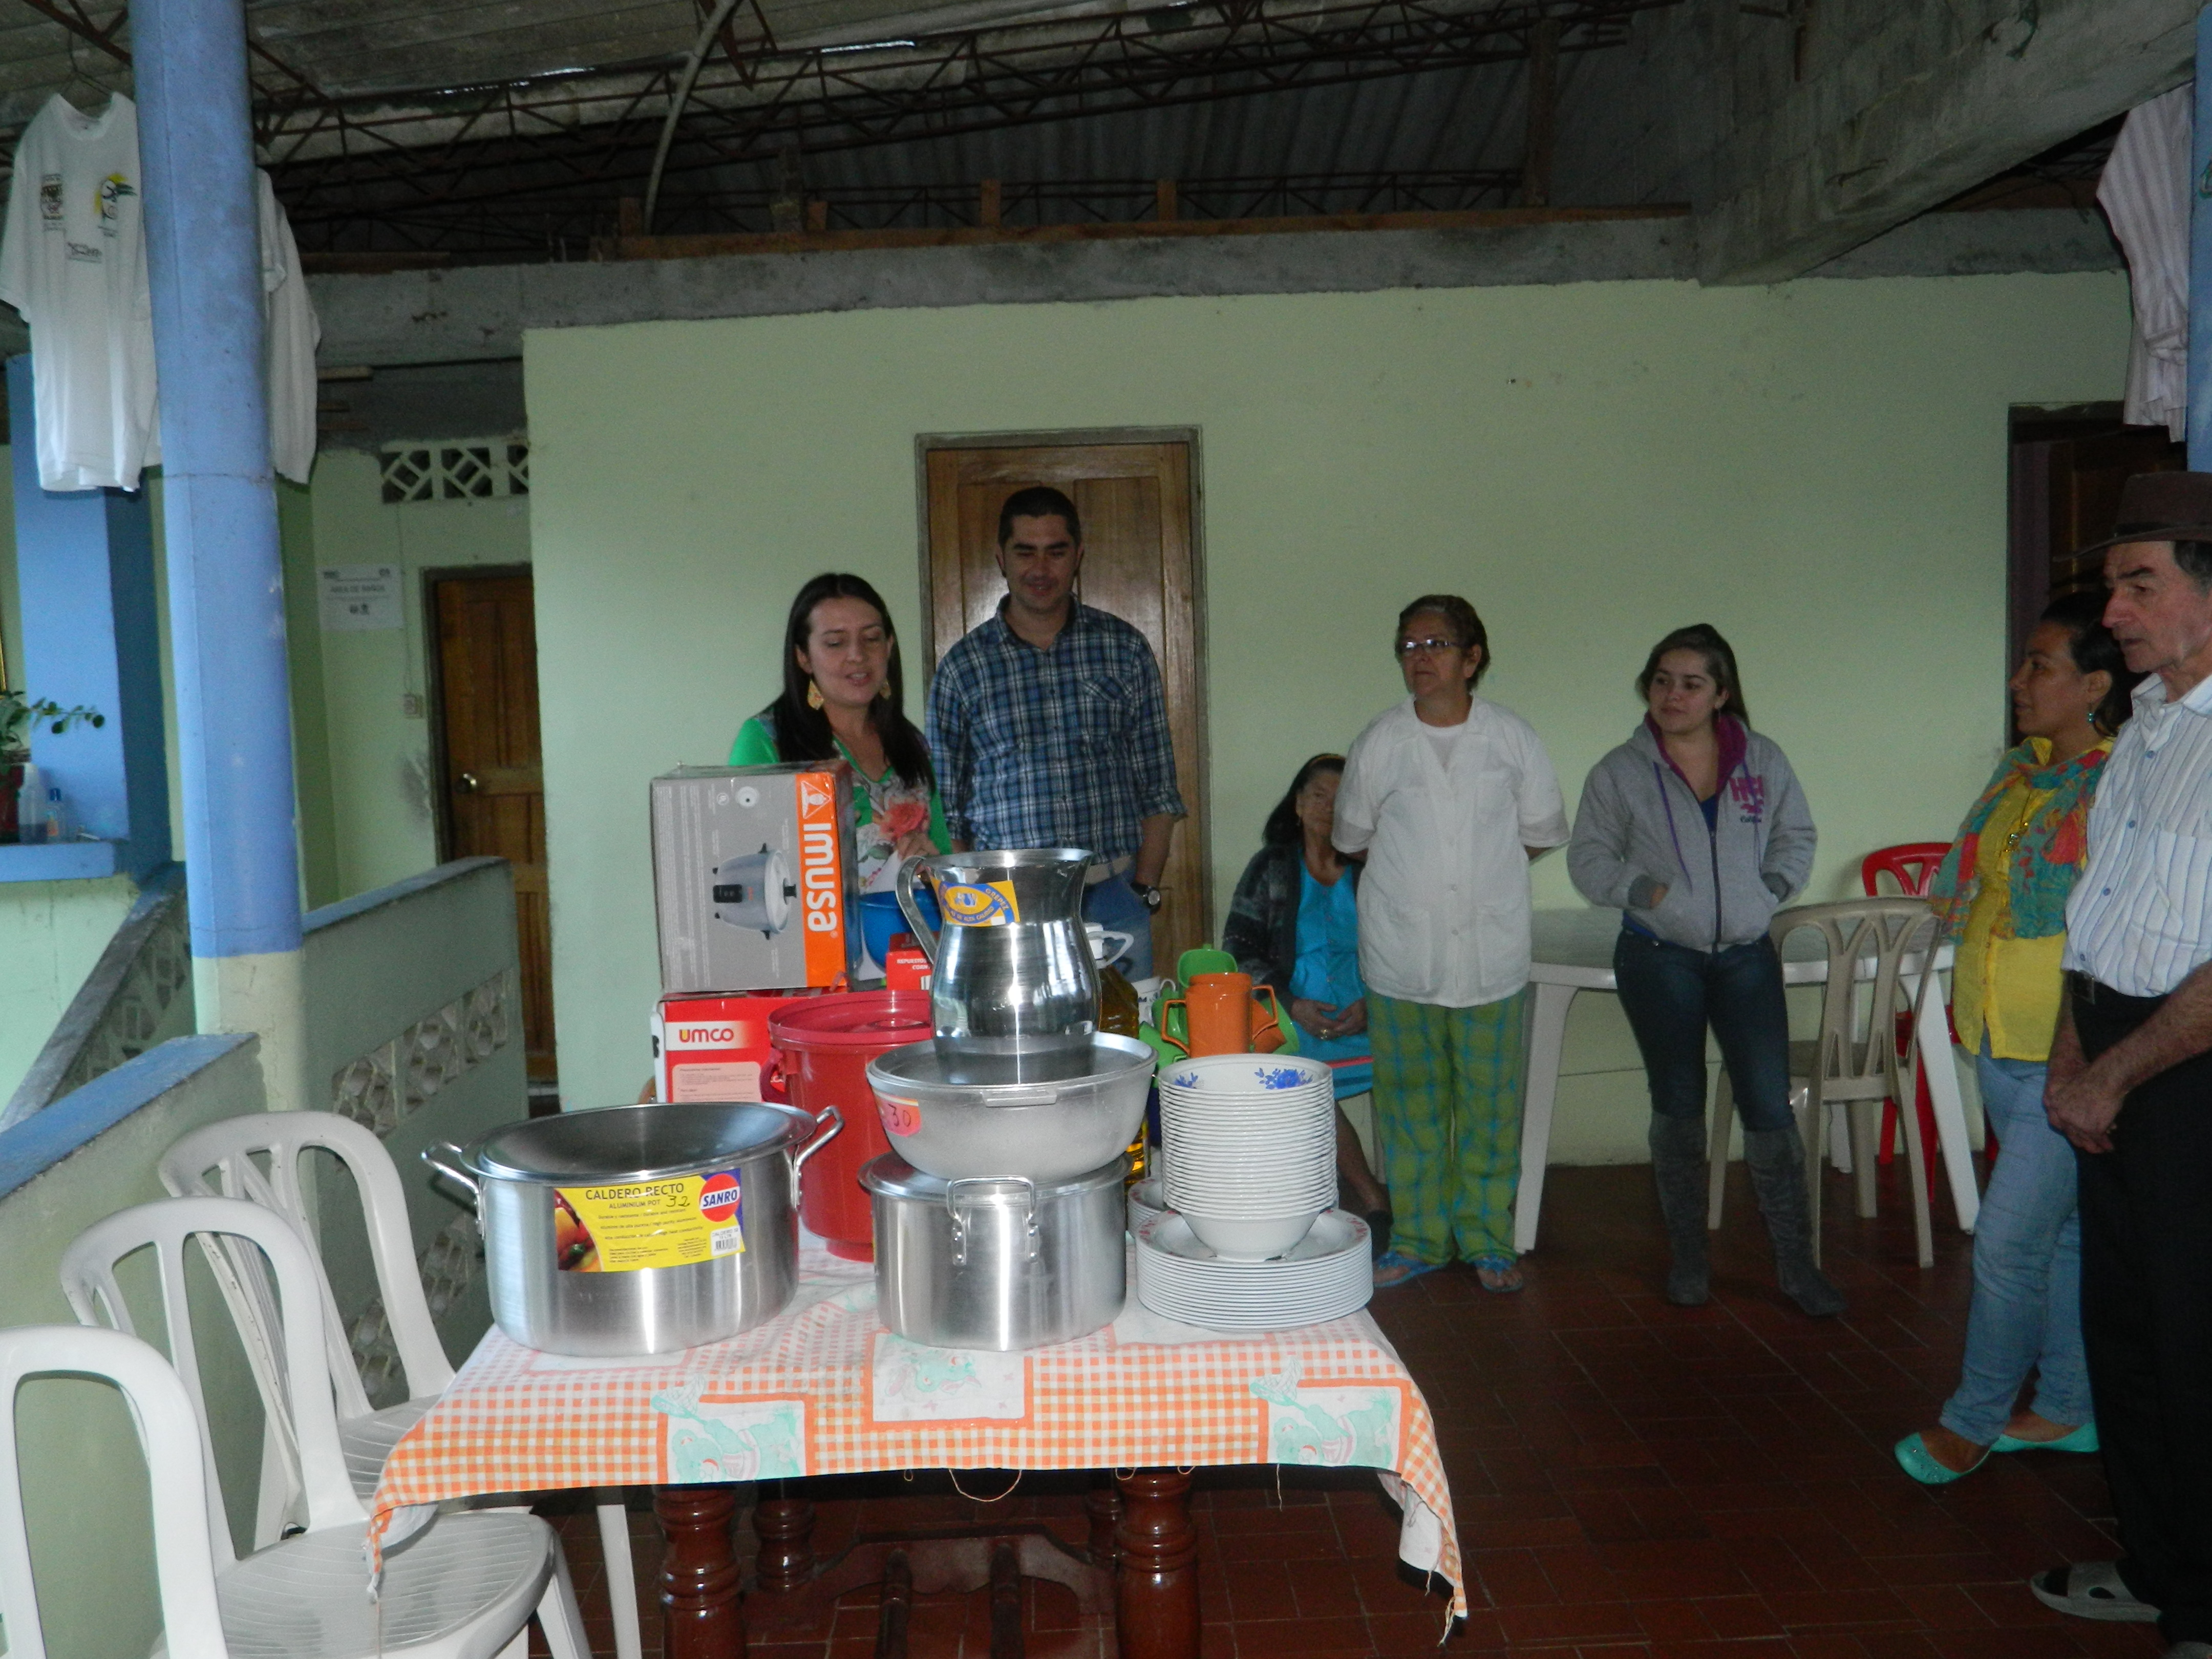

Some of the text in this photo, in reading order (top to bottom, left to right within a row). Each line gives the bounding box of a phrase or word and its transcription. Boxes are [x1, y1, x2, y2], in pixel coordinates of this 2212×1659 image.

[679, 1028, 734, 1043] umco
[888, 1103, 911, 1127] 30
[586, 1183, 684, 1200] CALDERO RECTO
[703, 1189, 737, 1207] SANRO
[609, 1200, 646, 1208] ALUMINIUM
[666, 1195, 690, 1207] 32
